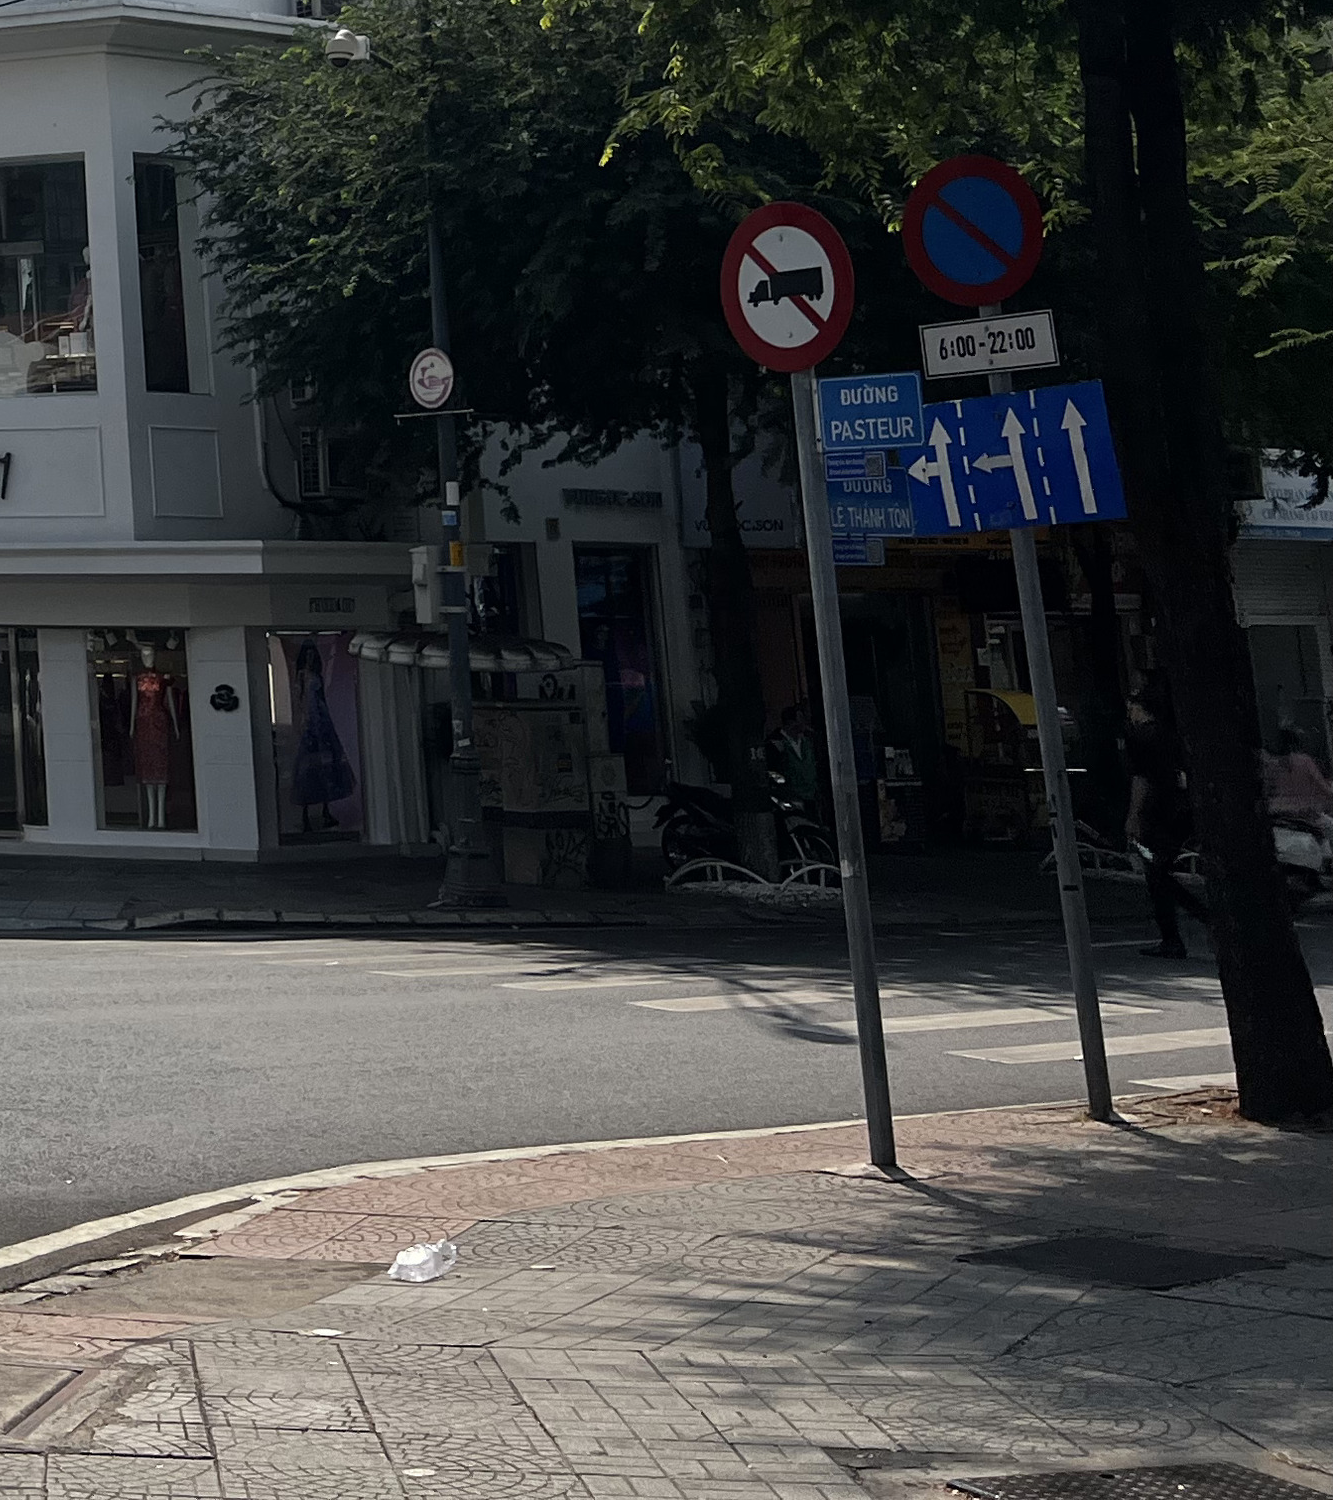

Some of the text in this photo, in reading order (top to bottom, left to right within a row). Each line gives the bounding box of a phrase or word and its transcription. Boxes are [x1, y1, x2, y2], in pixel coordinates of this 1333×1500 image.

[840, 384, 899, 406] ĐƯỜNG
[831, 416, 914, 442] PASTEUR
[888, 502, 911, 529] TÔN
